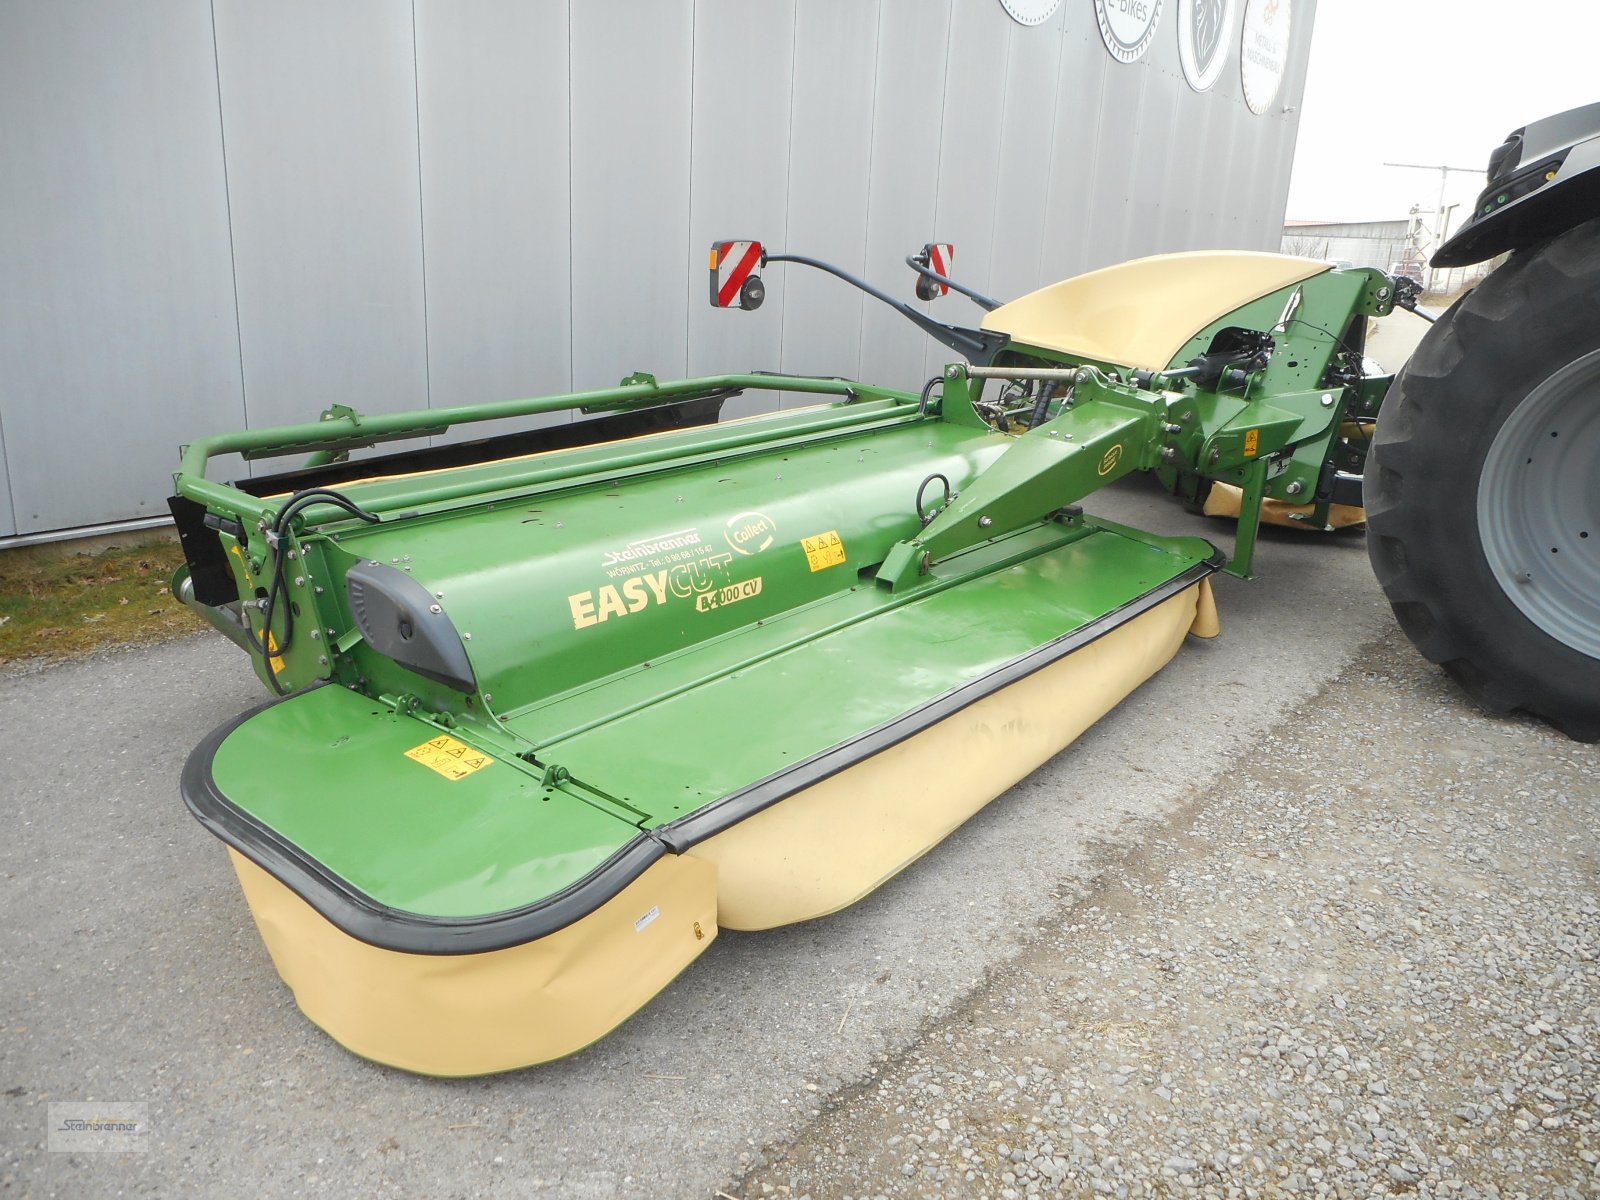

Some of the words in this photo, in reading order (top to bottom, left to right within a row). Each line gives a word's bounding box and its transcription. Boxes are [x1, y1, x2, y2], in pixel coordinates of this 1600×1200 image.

[734, 520, 768, 543] Collect
[601, 528, 701, 566] Steinbrenner
[606, 562, 646, 578] WÖRNITZ
[568, 552, 733, 630] EASYCUT
[742, 580, 758, 597] CV
